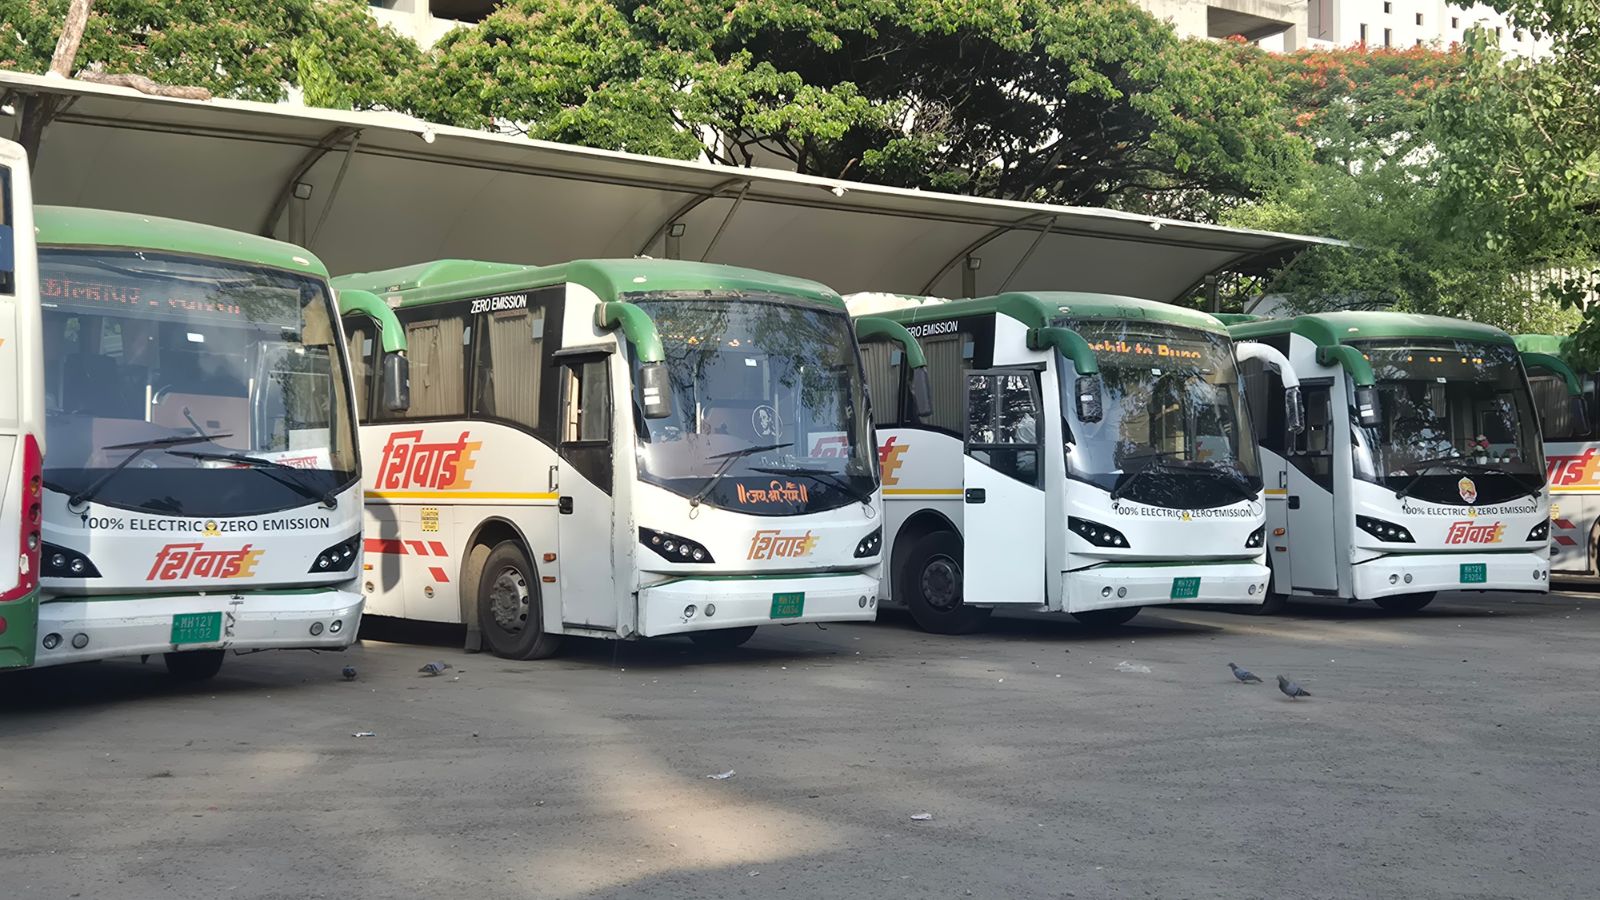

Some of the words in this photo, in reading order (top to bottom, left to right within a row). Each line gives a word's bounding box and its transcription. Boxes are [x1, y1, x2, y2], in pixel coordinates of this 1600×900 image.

[471, 298, 490, 314] ZERO
[491, 294, 528, 311] EMISSION
[922, 320, 958, 336] EMISSION
[1141, 508, 1181, 518] ELECTRIC
[1191, 509, 1212, 518] ZERO
[1214, 509, 1251, 518] EMISSION
[1427, 507, 1466, 516] ELECTRIC
[1477, 507, 1498, 516] ZERO
[1500, 506, 1537, 515] EMISSION
[130, 518, 201, 532] ELECTRIC
[220, 519, 258, 532] ZERO
[263, 517, 330, 531] EMISSION
